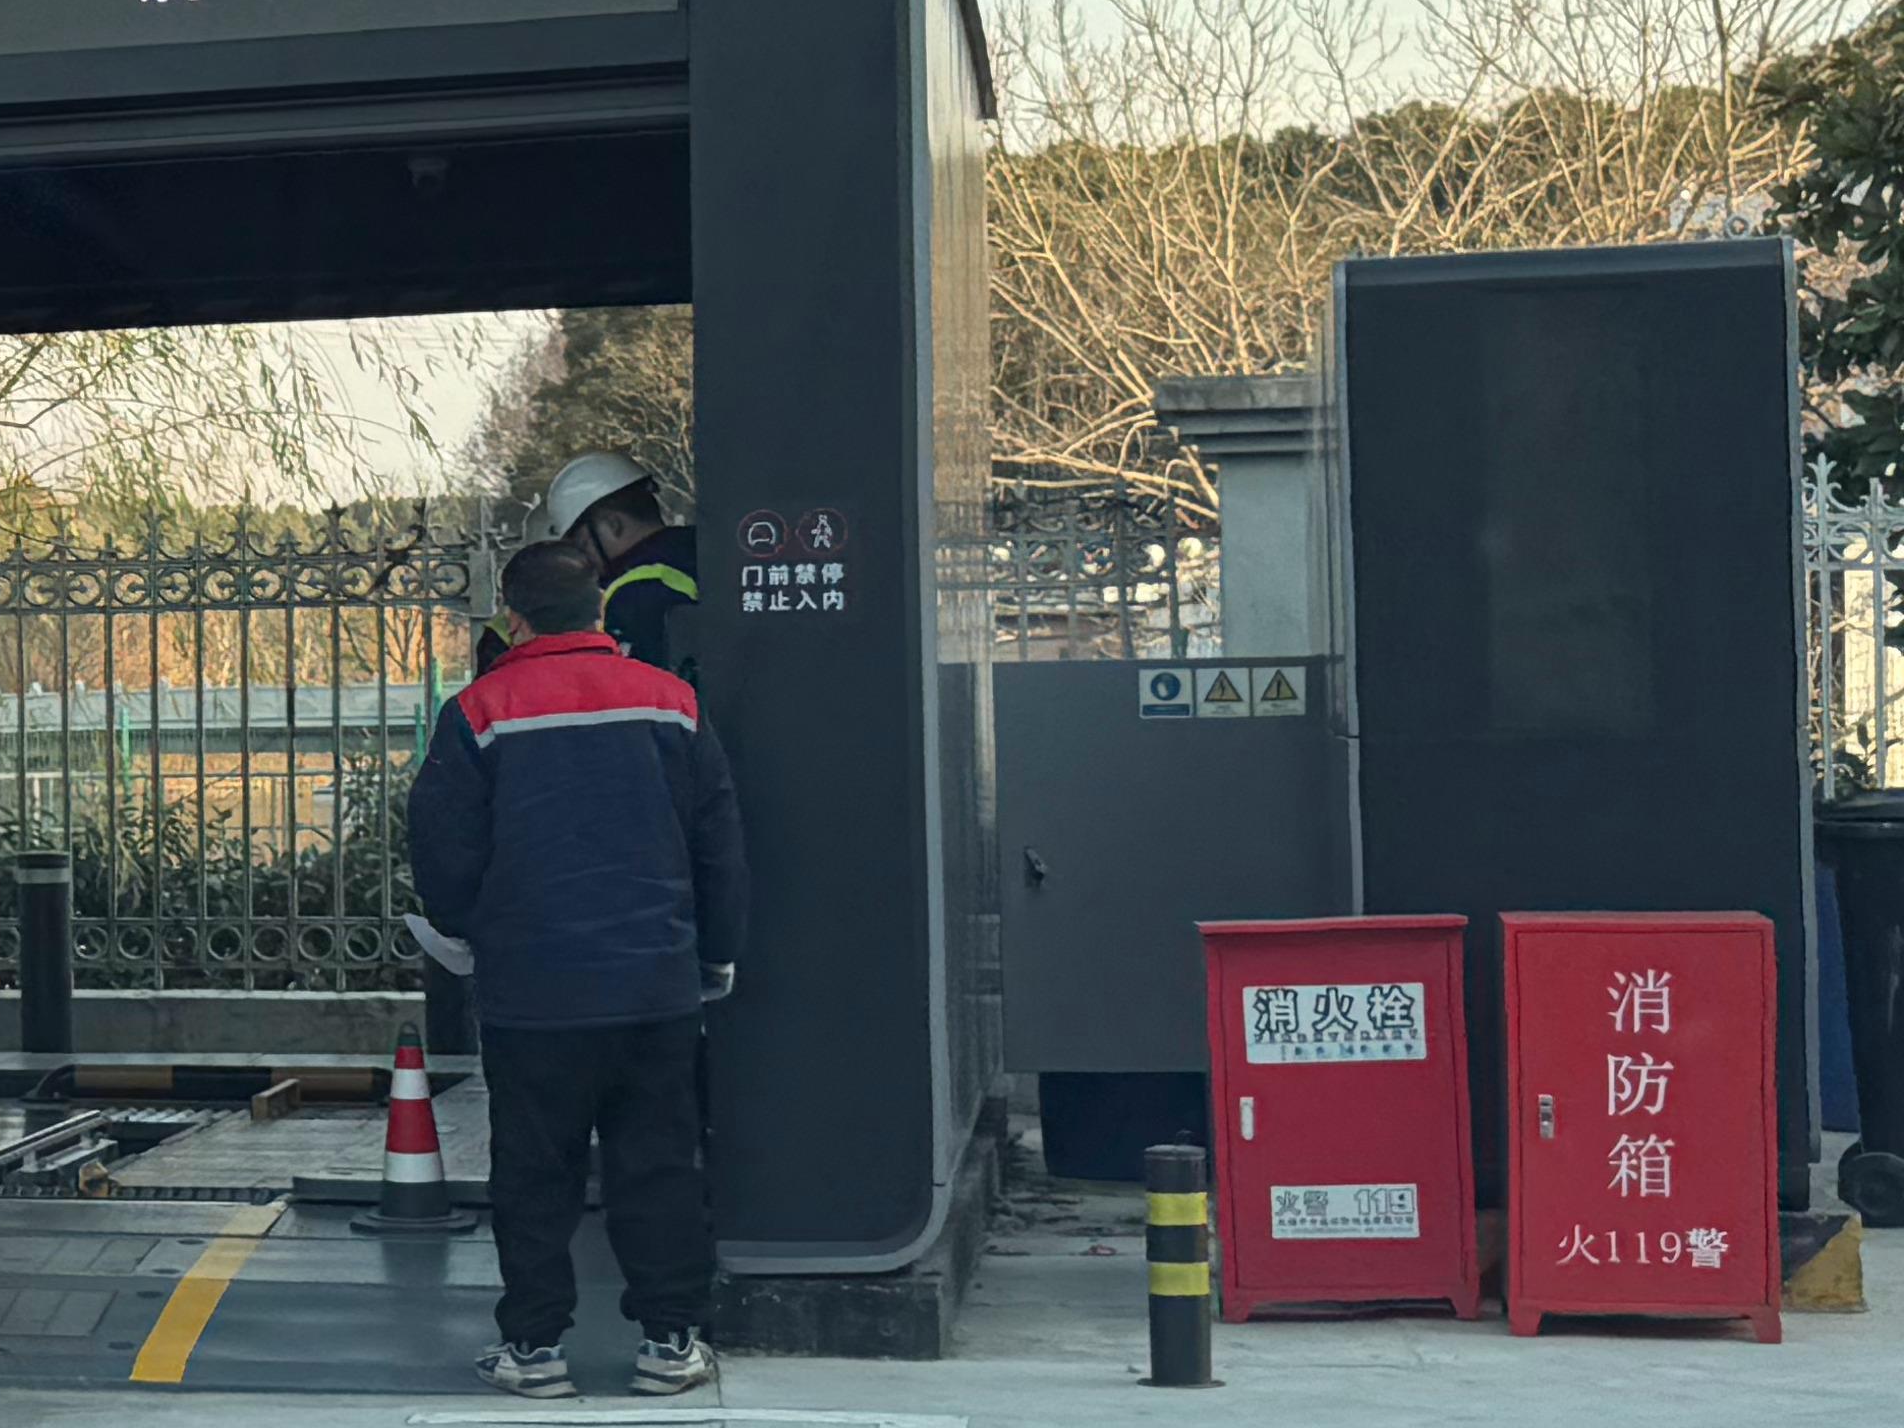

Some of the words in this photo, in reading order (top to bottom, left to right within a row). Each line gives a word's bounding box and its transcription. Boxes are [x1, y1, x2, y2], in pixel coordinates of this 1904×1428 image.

[741, 562, 844, 588] 门前禁停
[742, 589, 845, 613] 禁止入内
[1252, 984, 1416, 1034] 消火栓
[1606, 968, 1676, 1199] 消防箱
[1353, 1187, 1415, 1215] 119
